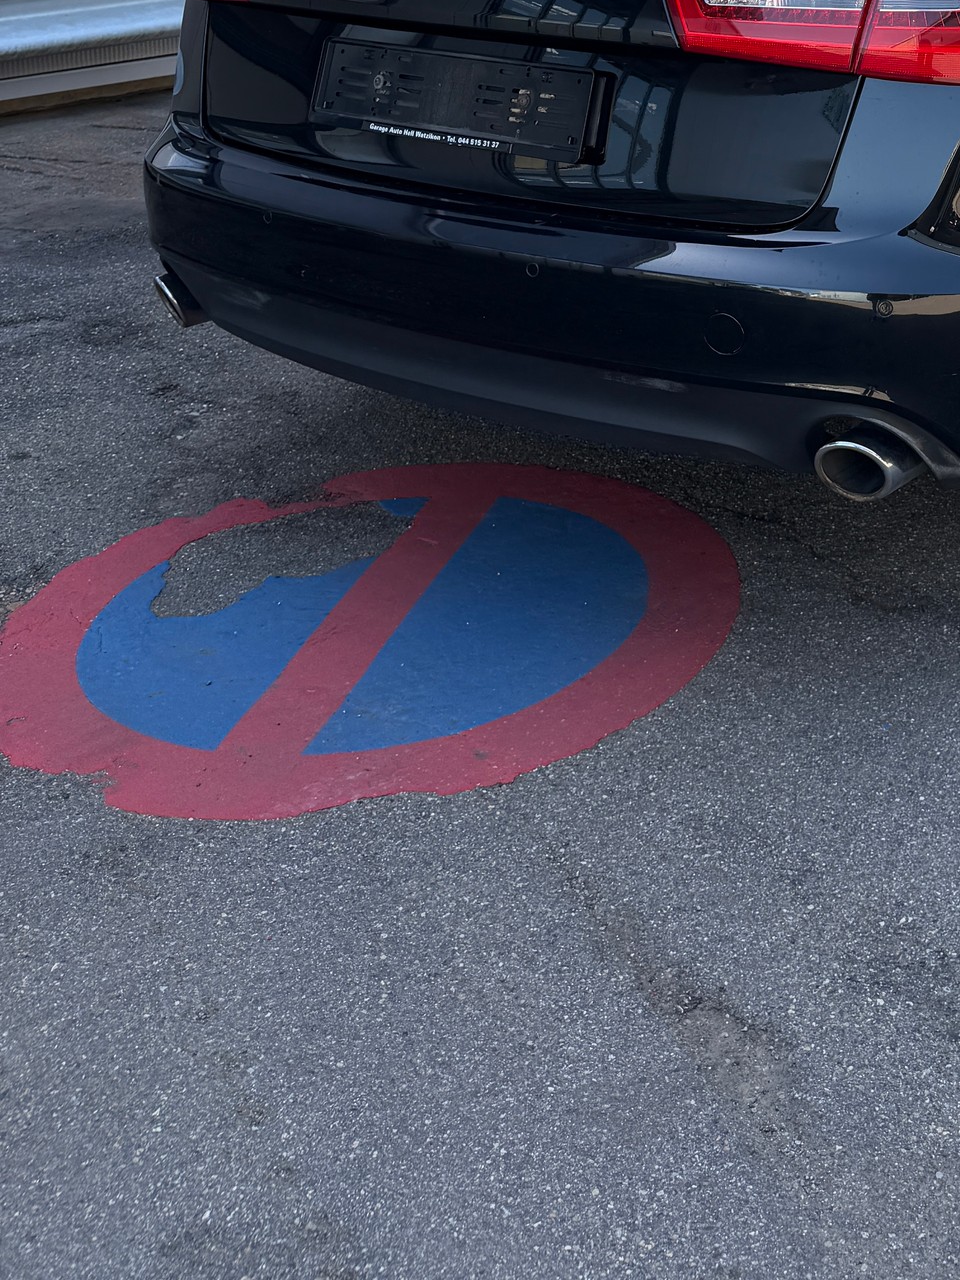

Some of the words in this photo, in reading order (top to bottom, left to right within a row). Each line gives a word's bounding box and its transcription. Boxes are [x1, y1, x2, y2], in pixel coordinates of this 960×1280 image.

[369, 123, 388, 133] Garage
[389, 126, 402, 135] Auto
[415, 130, 441, 141] Wetzikon
[447, 135, 457, 143] Tel.
[457, 137, 469, 145] 044
[469, 138, 482, 146] 515
[482, 140, 490, 148] 31
[491, 141, 500, 149] 37
